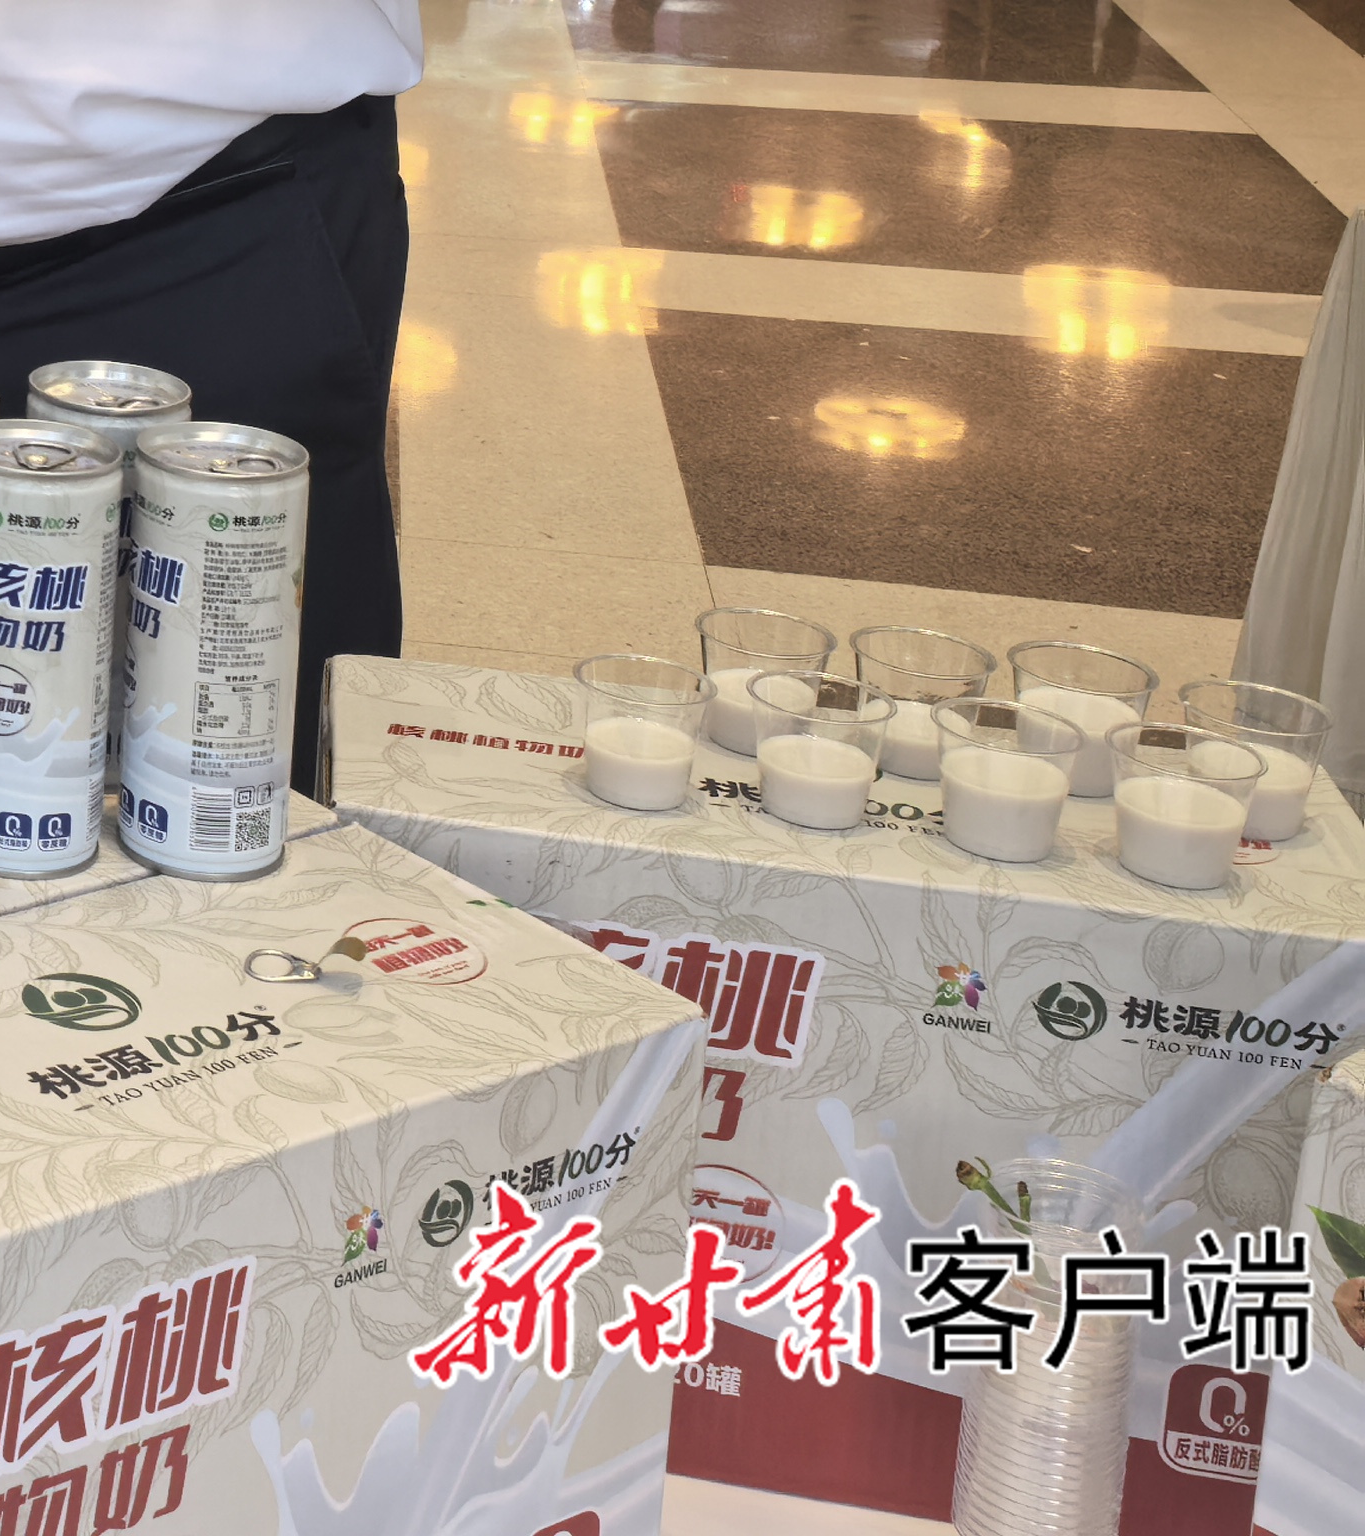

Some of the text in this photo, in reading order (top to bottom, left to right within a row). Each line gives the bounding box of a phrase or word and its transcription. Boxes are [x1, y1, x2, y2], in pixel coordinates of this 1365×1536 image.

[7, 512, 80, 530] 桃源100分
[922, 1012, 992, 1034] GANWEI
[1119, 994, 1341, 1056] 桃源100分
[26, 1011, 281, 1100] 桃源100分
[1146, 1037, 1303, 1071] TAO YUAN 100 FEN
[99, 1046, 279, 1107] TAO YUAN 100 FEN
[567, 1186, 585, 1203] 100
[588, 1177, 613, 1197] FEN
[334, 1258, 387, 1288] GANWEI
[1199, 1377, 1250, 1437] 0%
